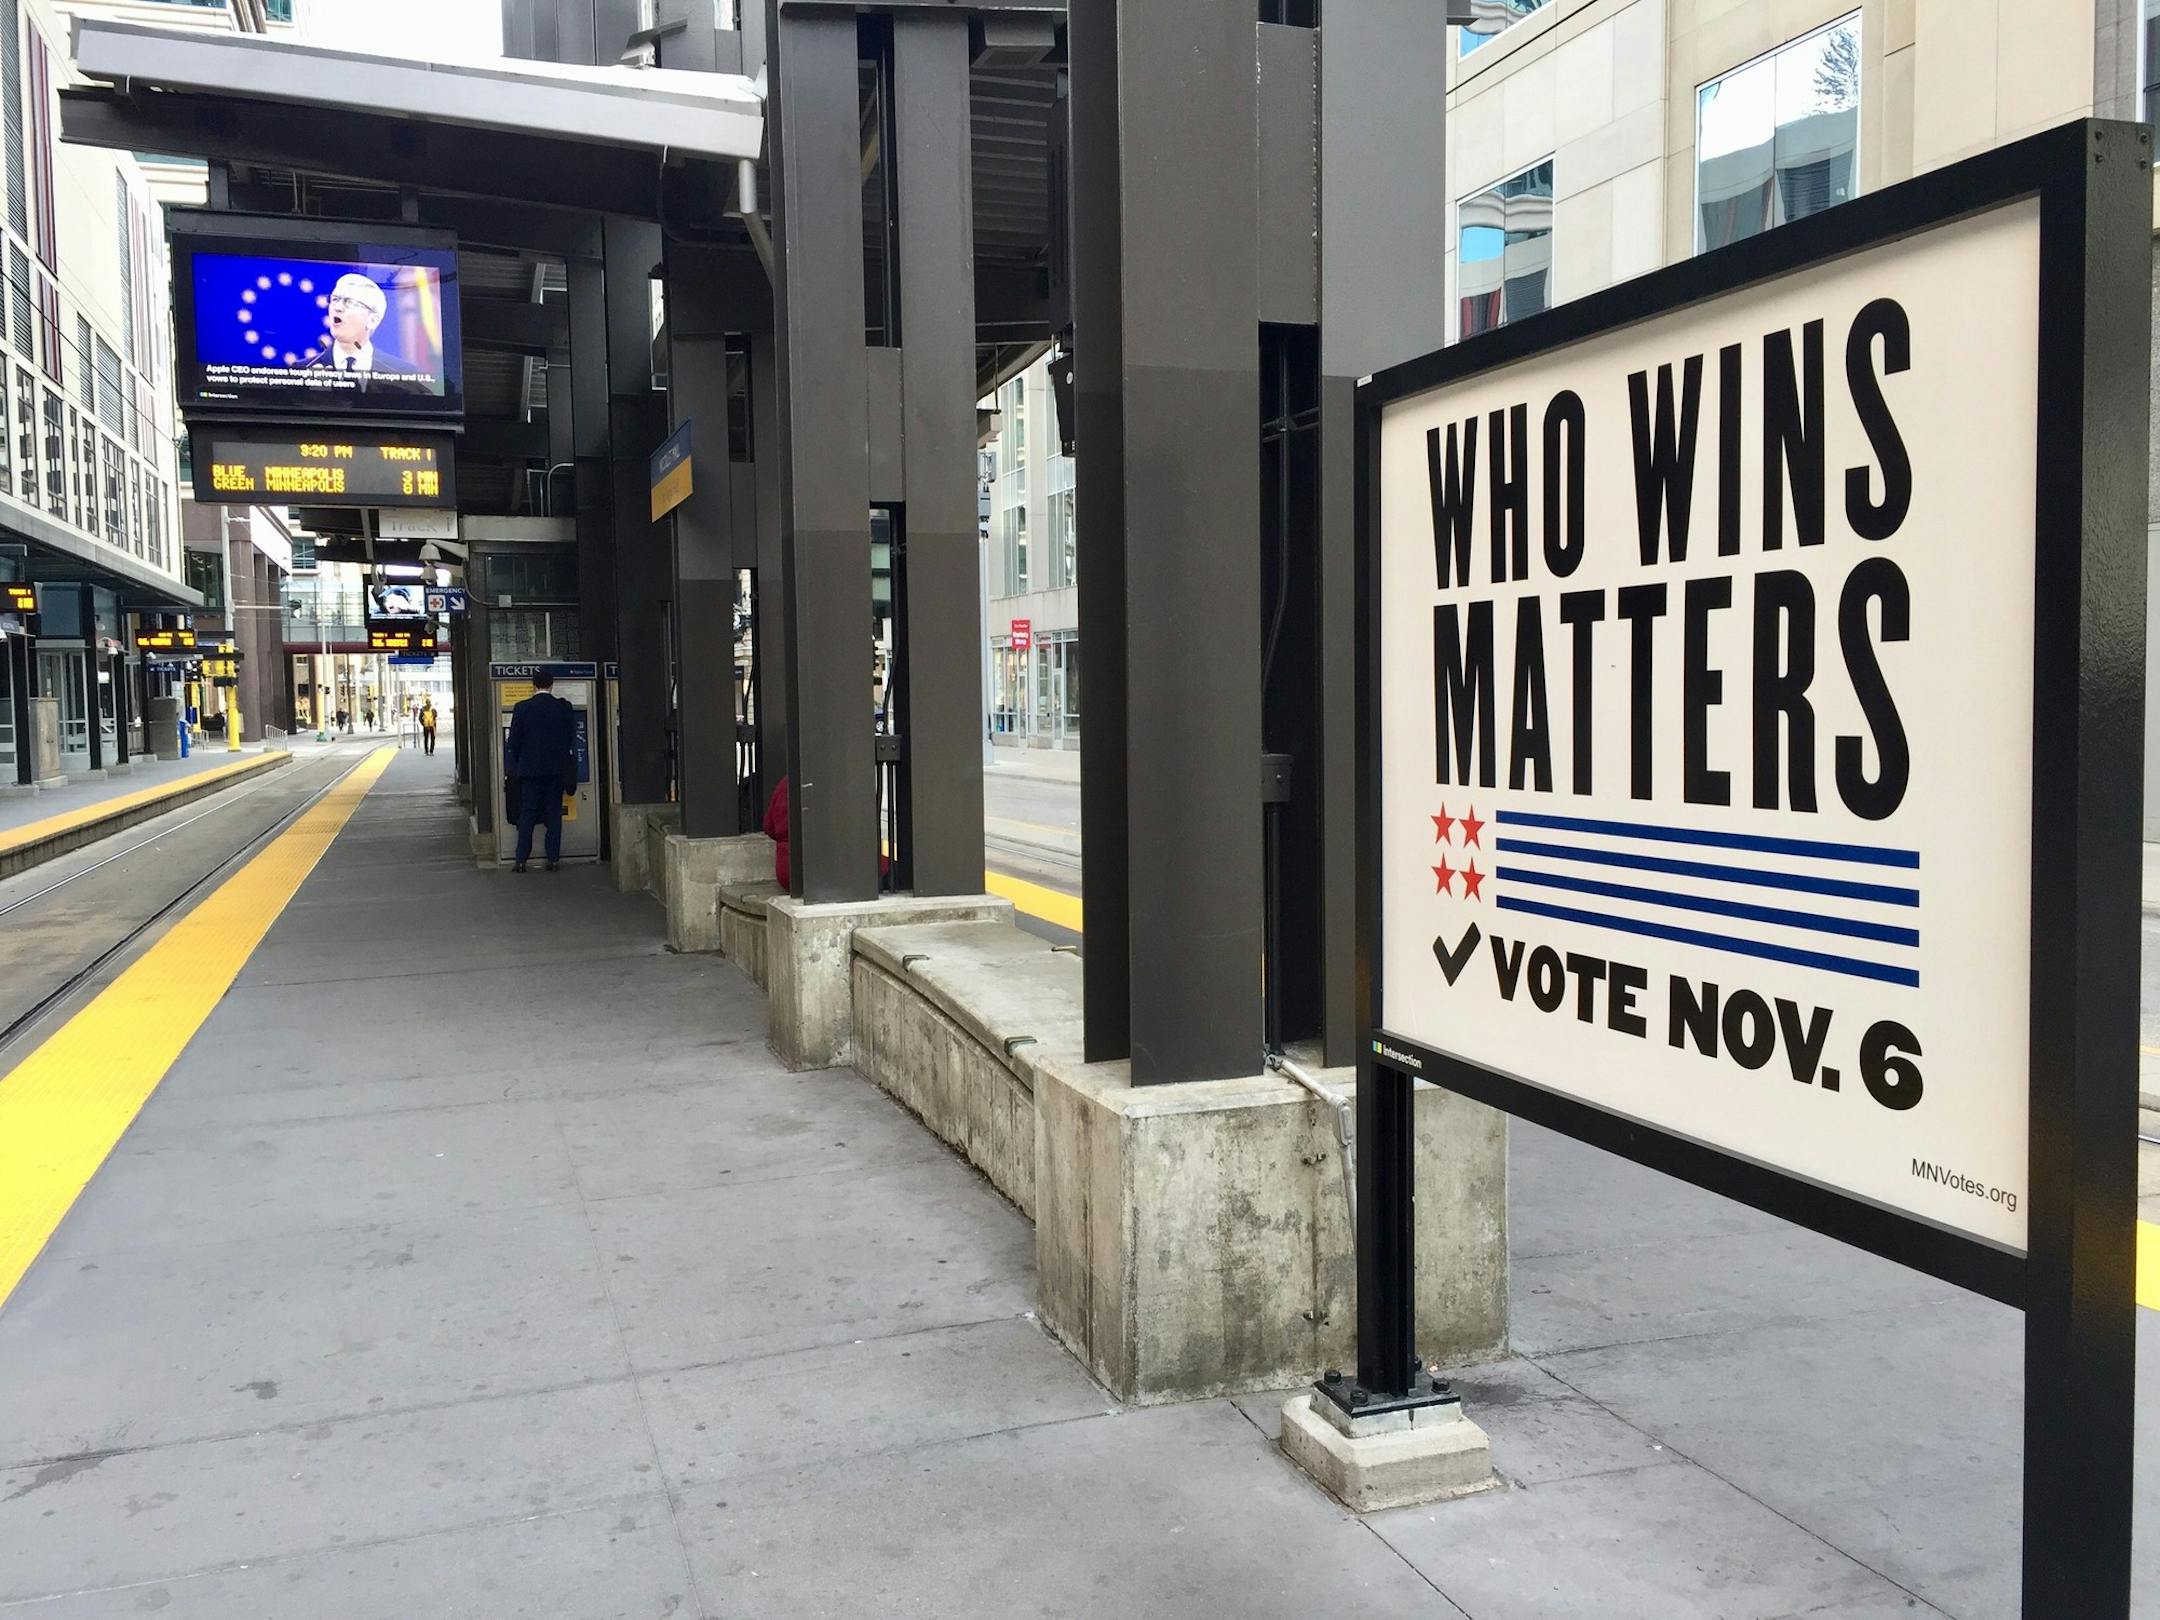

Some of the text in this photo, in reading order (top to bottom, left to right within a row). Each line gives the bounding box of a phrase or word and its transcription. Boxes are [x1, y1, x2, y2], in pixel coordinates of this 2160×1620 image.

[206, 364, 230, 374] Apple
[231, 365, 250, 374] CEO
[251, 367, 288, 376] endorses
[289, 368, 312, 378] tough
[313, 370, 343, 381] privacy
[344, 371, 362, 379] laws
[363, 371, 371, 379] in
[372, 372, 400, 382] Europe
[401, 373, 416, 381] and
[206, 375, 228, 383] vows
[229, 375, 238, 383] to
[239, 376, 268, 386] protect
[269, 378, 303, 386] personal
[304, 379, 322, 387] data
[333, 380, 355, 388] users
[335, 445, 352, 459] PM
[380, 446, 420, 461] TRACK
[1427, 298, 1911, 589] WHO WINS
[212, 464, 438, 484] BLUE MINNEAPOLIS 3 MIN
[213, 477, 254, 490] GREEN
[266, 478, 345, 493] MINNEAPOLIS
[418, 483, 439, 496] MIN
[1434, 557, 1909, 820] MATTERS
[1490, 936, 1923, 1110] VOTE NOV. 6
[1383, 1044, 1422, 1068] Intersection
[1911, 1158, 2017, 1212] MNVotes.org
